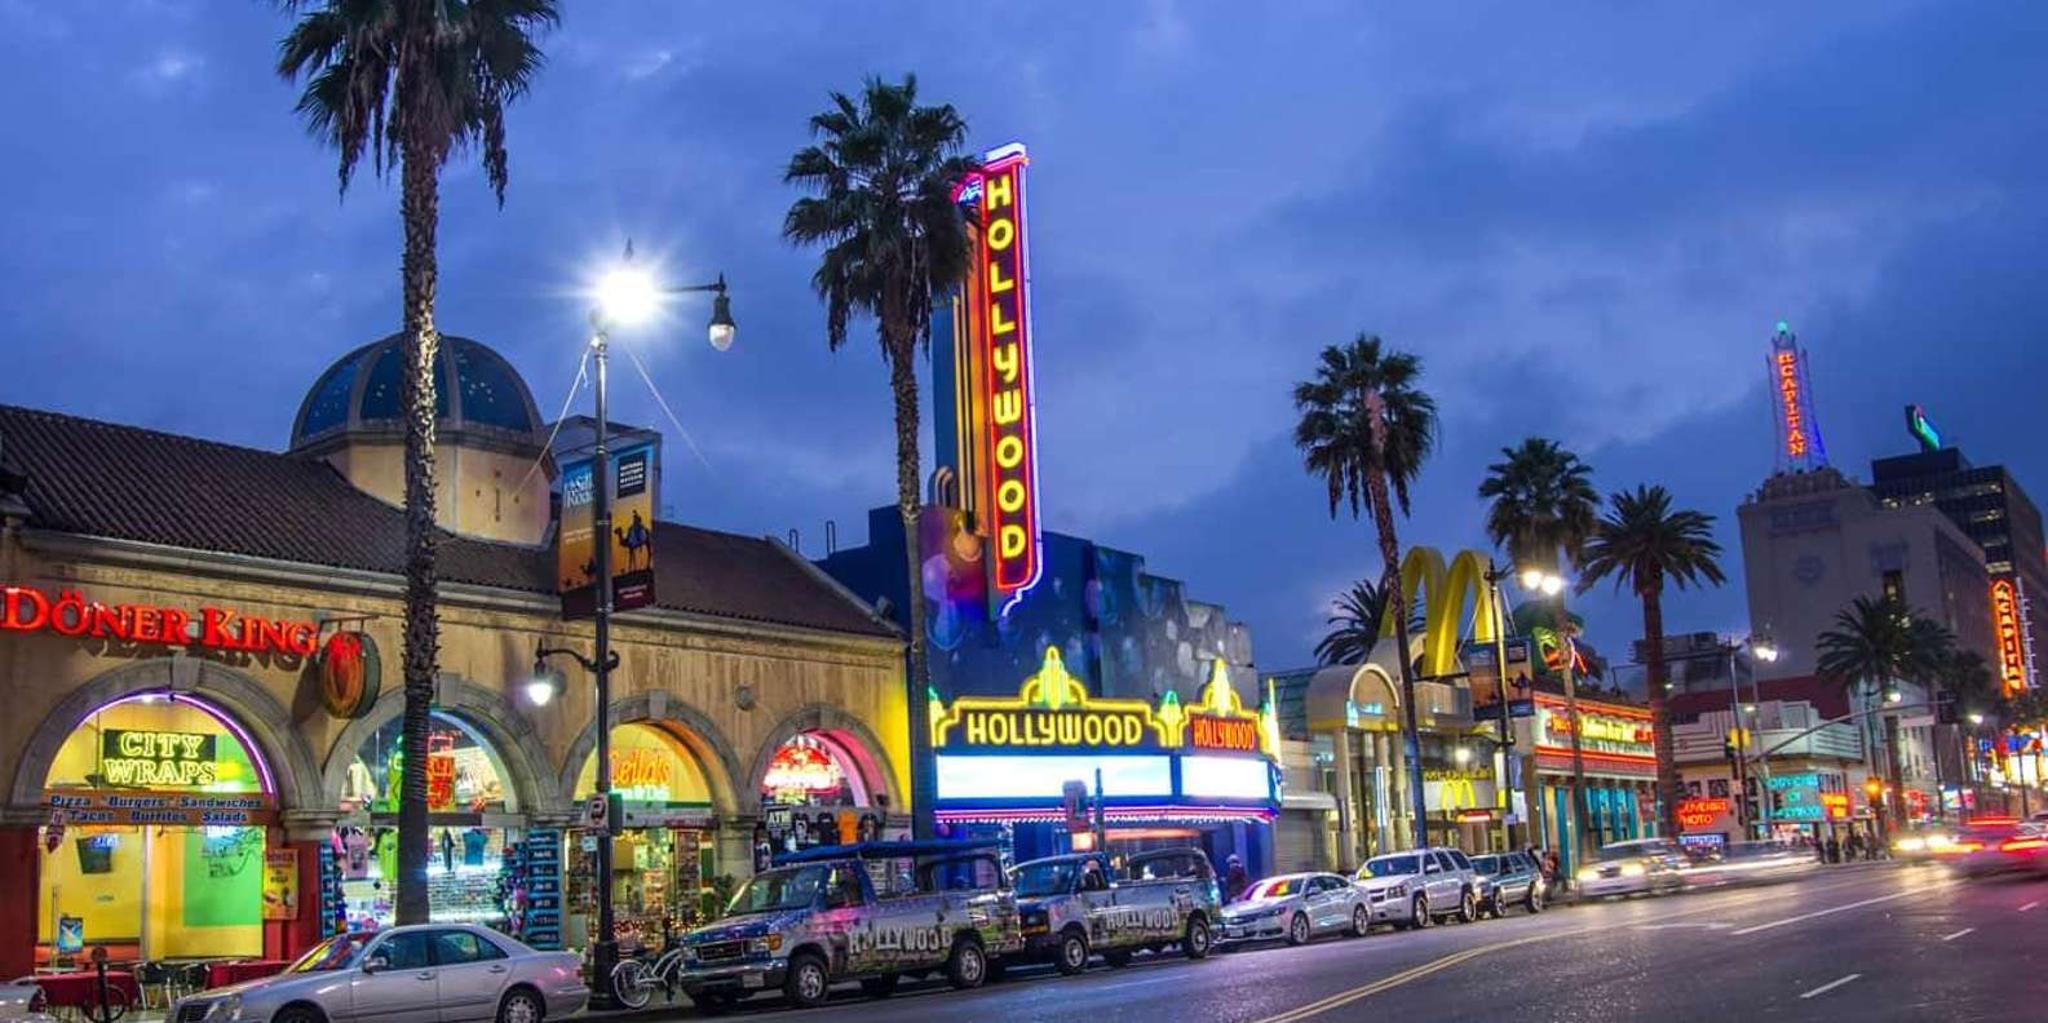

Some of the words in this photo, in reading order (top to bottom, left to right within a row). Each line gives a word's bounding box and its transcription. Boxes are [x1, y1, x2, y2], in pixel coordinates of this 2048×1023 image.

[986, 175, 1027, 559] HOLLYWOOD
[0, 585, 191, 643] DÖNER
[200, 607, 317, 655] KING
[967, 713, 1143, 745] HOLLYWOOD
[1193, 718, 1256, 750] HOLLYWOOD
[120, 732, 204, 758] CITY
[104, 758, 216, 785] WRAPS
[50, 795, 91, 808] Pizza
[181, 796, 262, 808] Sandwiches
[69, 810, 116, 821] Tacos
[131, 810, 187, 822] Burritos
[202, 811, 248, 822] Salads
